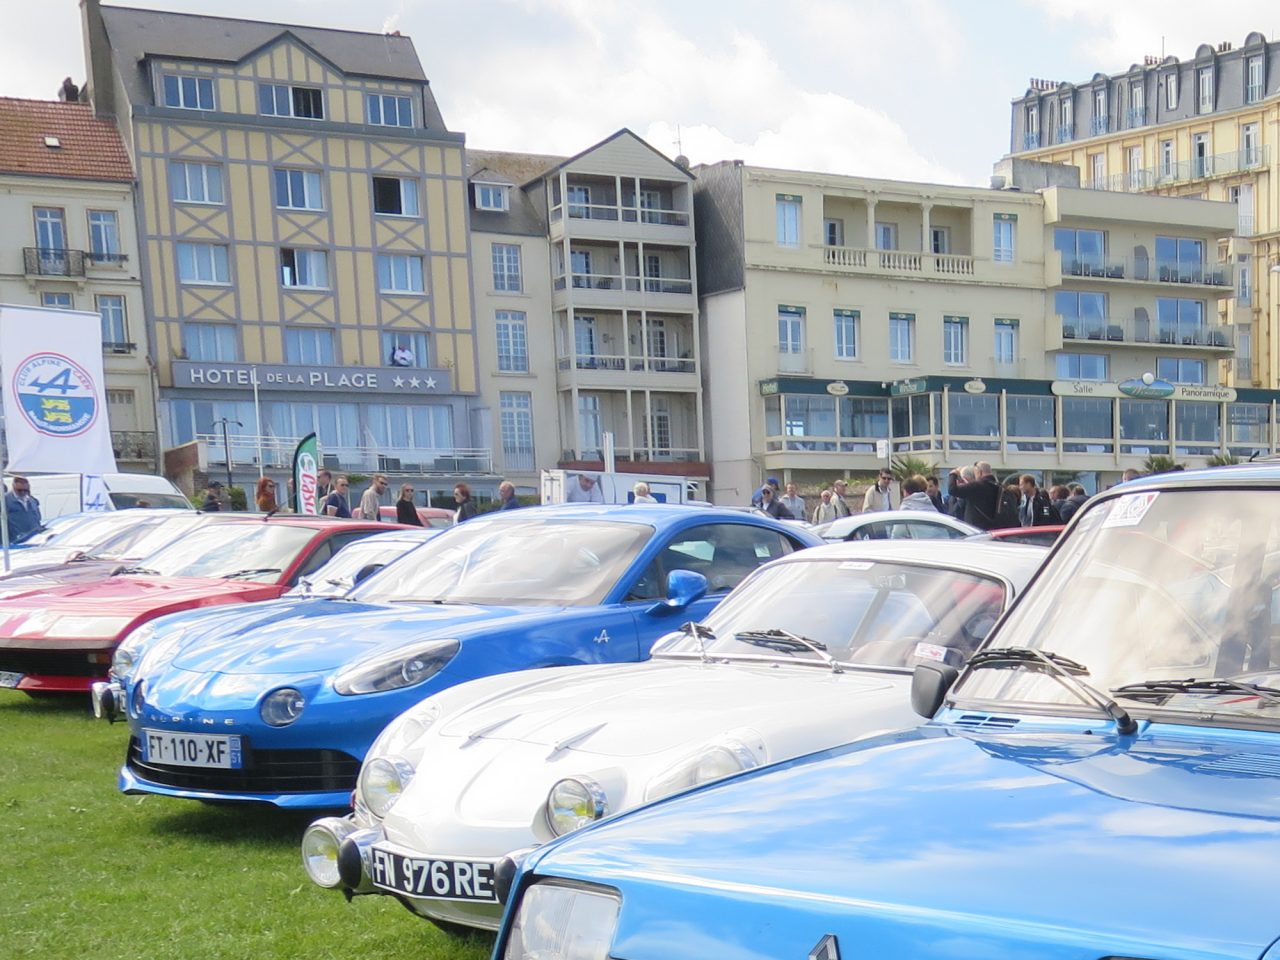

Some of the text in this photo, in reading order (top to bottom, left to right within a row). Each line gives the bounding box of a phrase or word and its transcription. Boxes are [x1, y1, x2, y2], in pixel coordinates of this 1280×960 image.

[190, 368, 377, 388] HOTEL DE LA PLAGE
[1073, 384, 1094, 394] Salle
[1181, 387, 1230, 399] Panoramique
[149, 735, 226, 763] FT-110-XF
[374, 850, 493, 897] FN 976 RE
